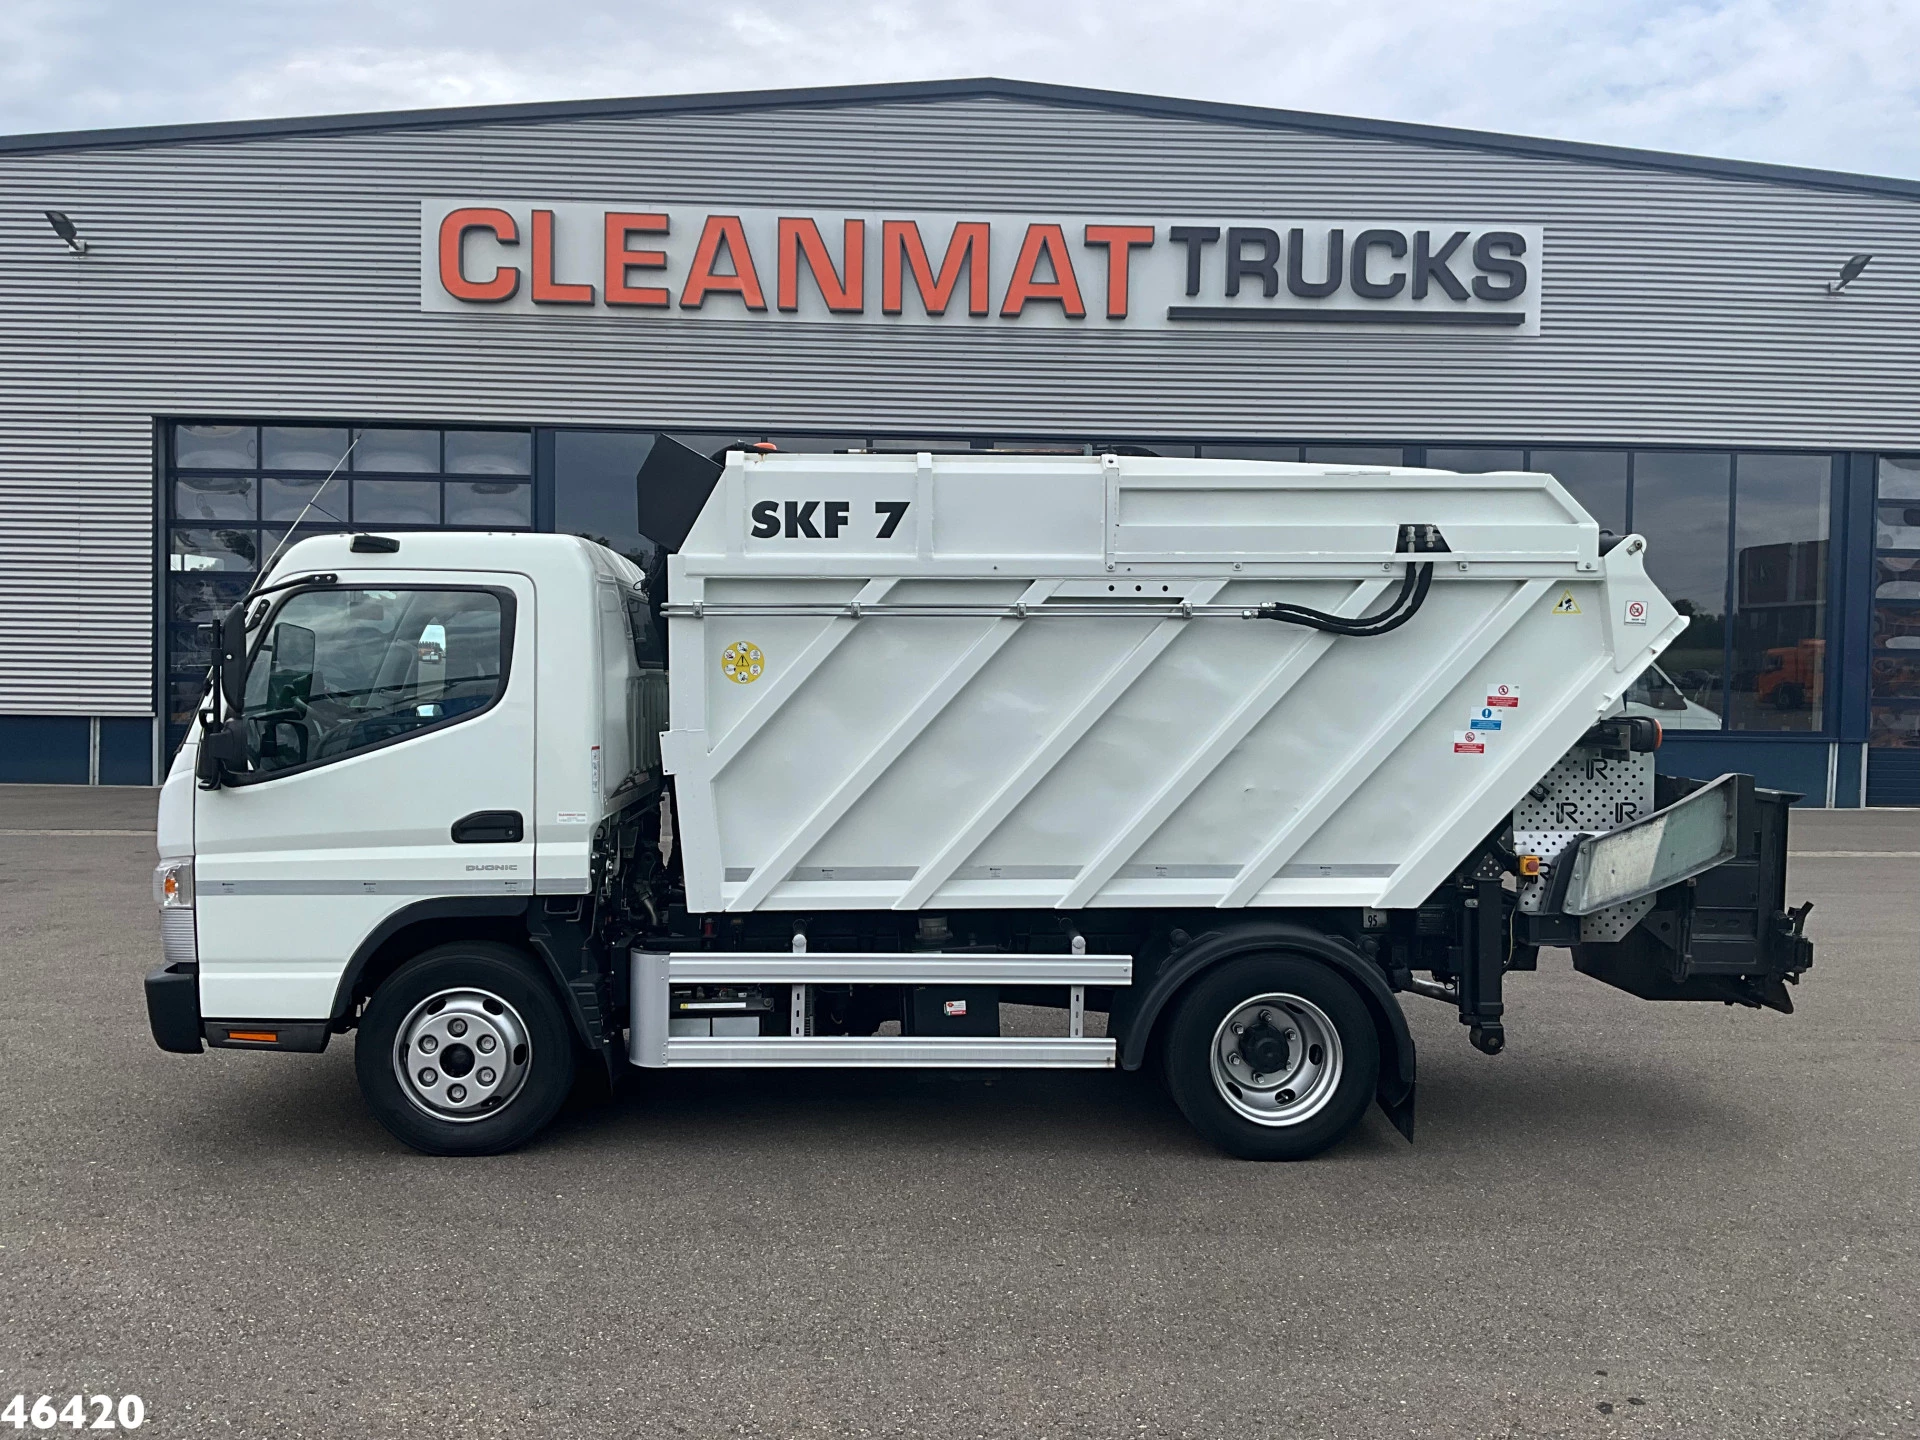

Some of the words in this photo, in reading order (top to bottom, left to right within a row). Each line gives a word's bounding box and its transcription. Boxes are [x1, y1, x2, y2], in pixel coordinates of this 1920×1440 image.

[438, 207, 1155, 319] CLEANMAT
[1169, 225, 1527, 301] TRUCKS
[750, 500, 850, 539] SKF
[874, 501, 911, 539] 7
[1367, 914, 1378, 927] 95
